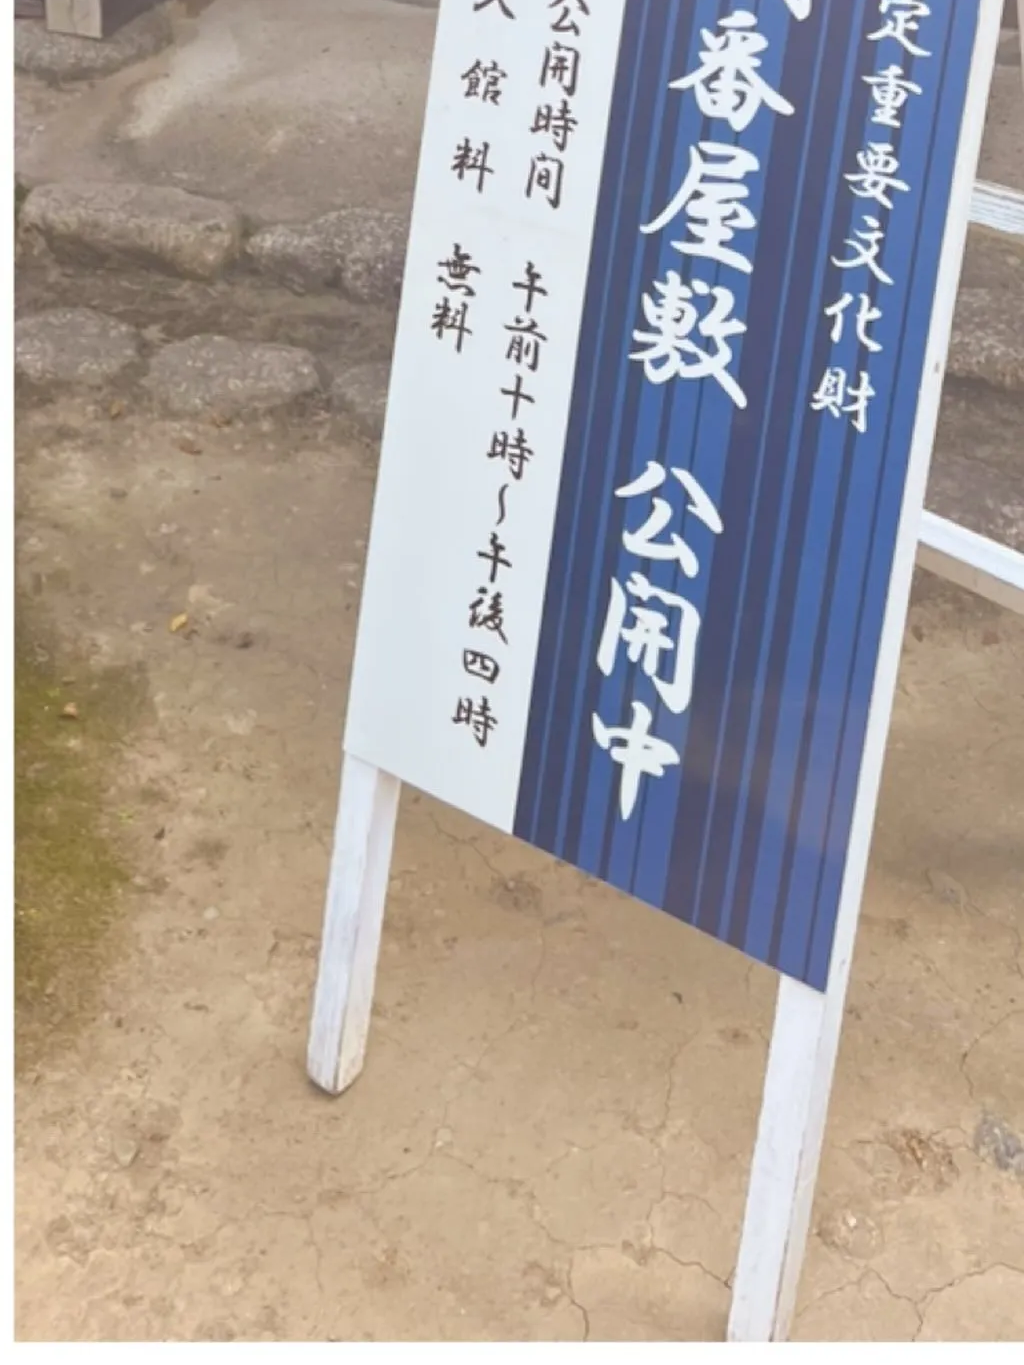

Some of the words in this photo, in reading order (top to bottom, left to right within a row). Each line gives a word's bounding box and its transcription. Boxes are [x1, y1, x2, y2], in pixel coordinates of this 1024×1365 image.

[431, 243, 481, 354] 無料
[592, 460, 724, 821] 公開中
